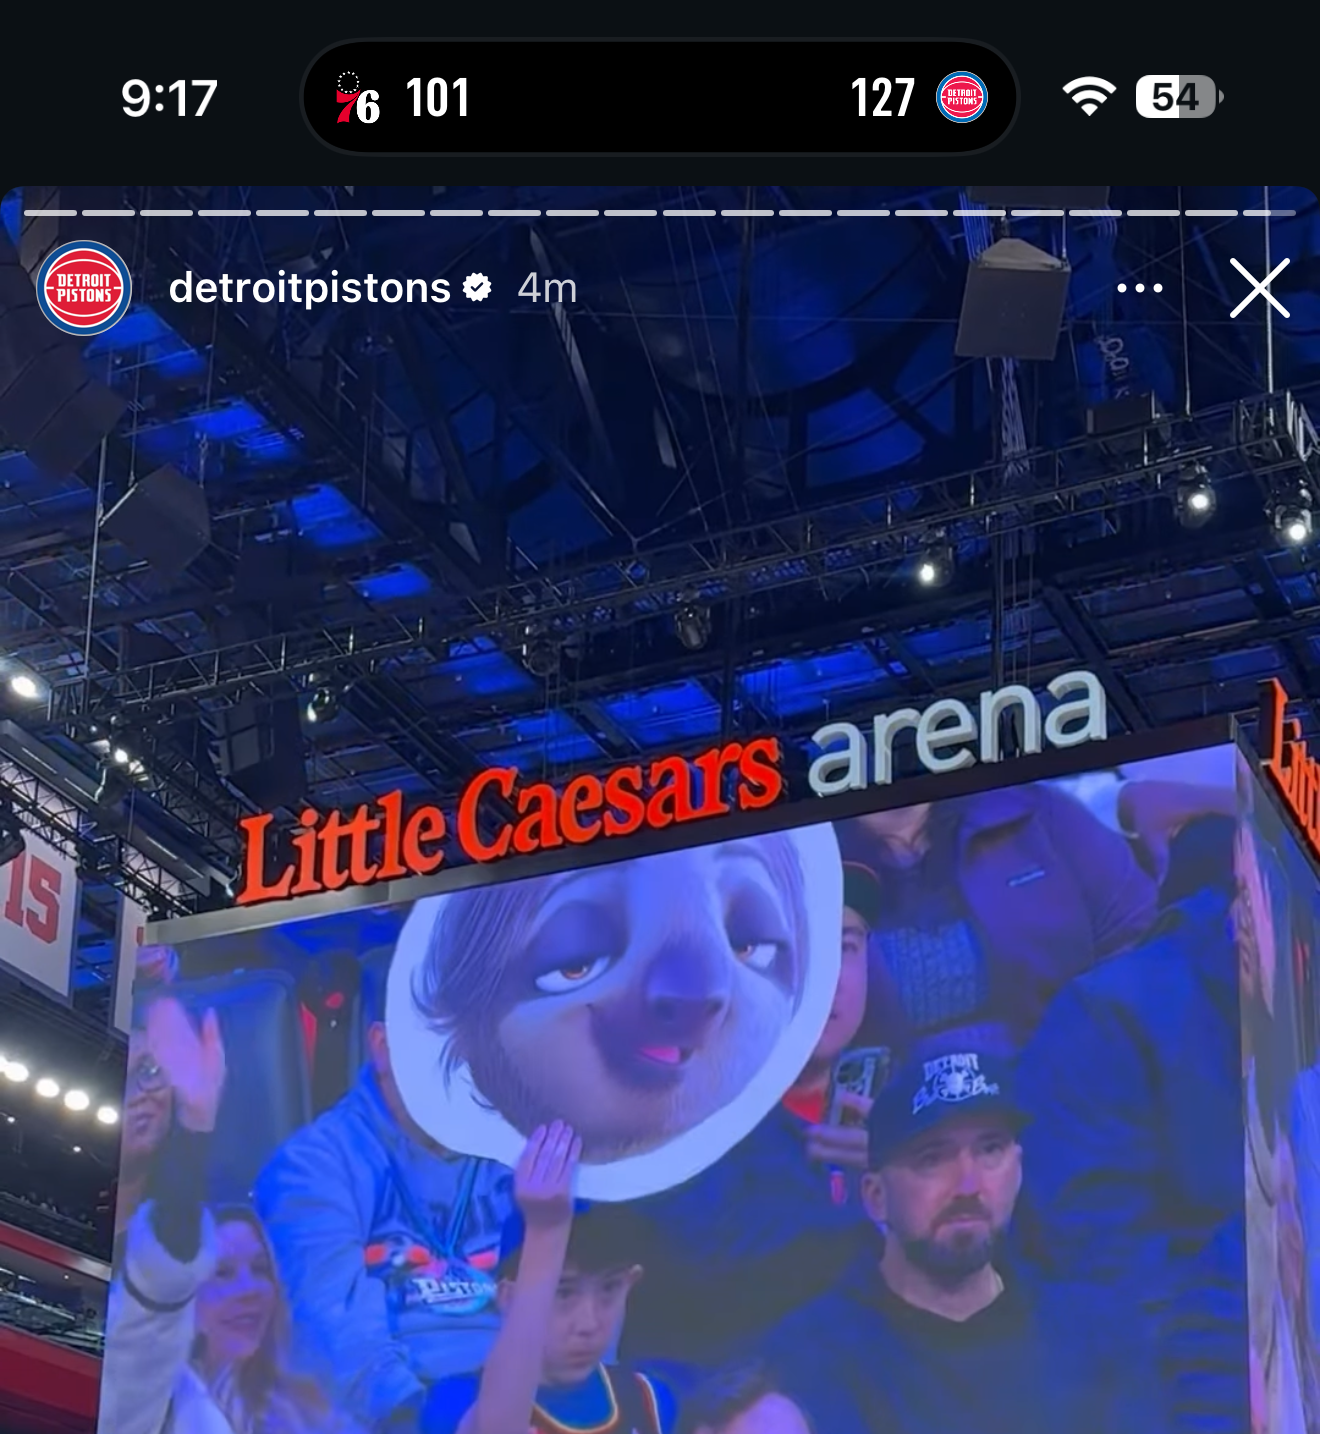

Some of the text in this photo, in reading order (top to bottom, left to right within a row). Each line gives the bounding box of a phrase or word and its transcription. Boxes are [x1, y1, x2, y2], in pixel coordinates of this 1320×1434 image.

[237, 670, 1108, 903] Little Caesars arena
[4, 850, 62, 944] 15
